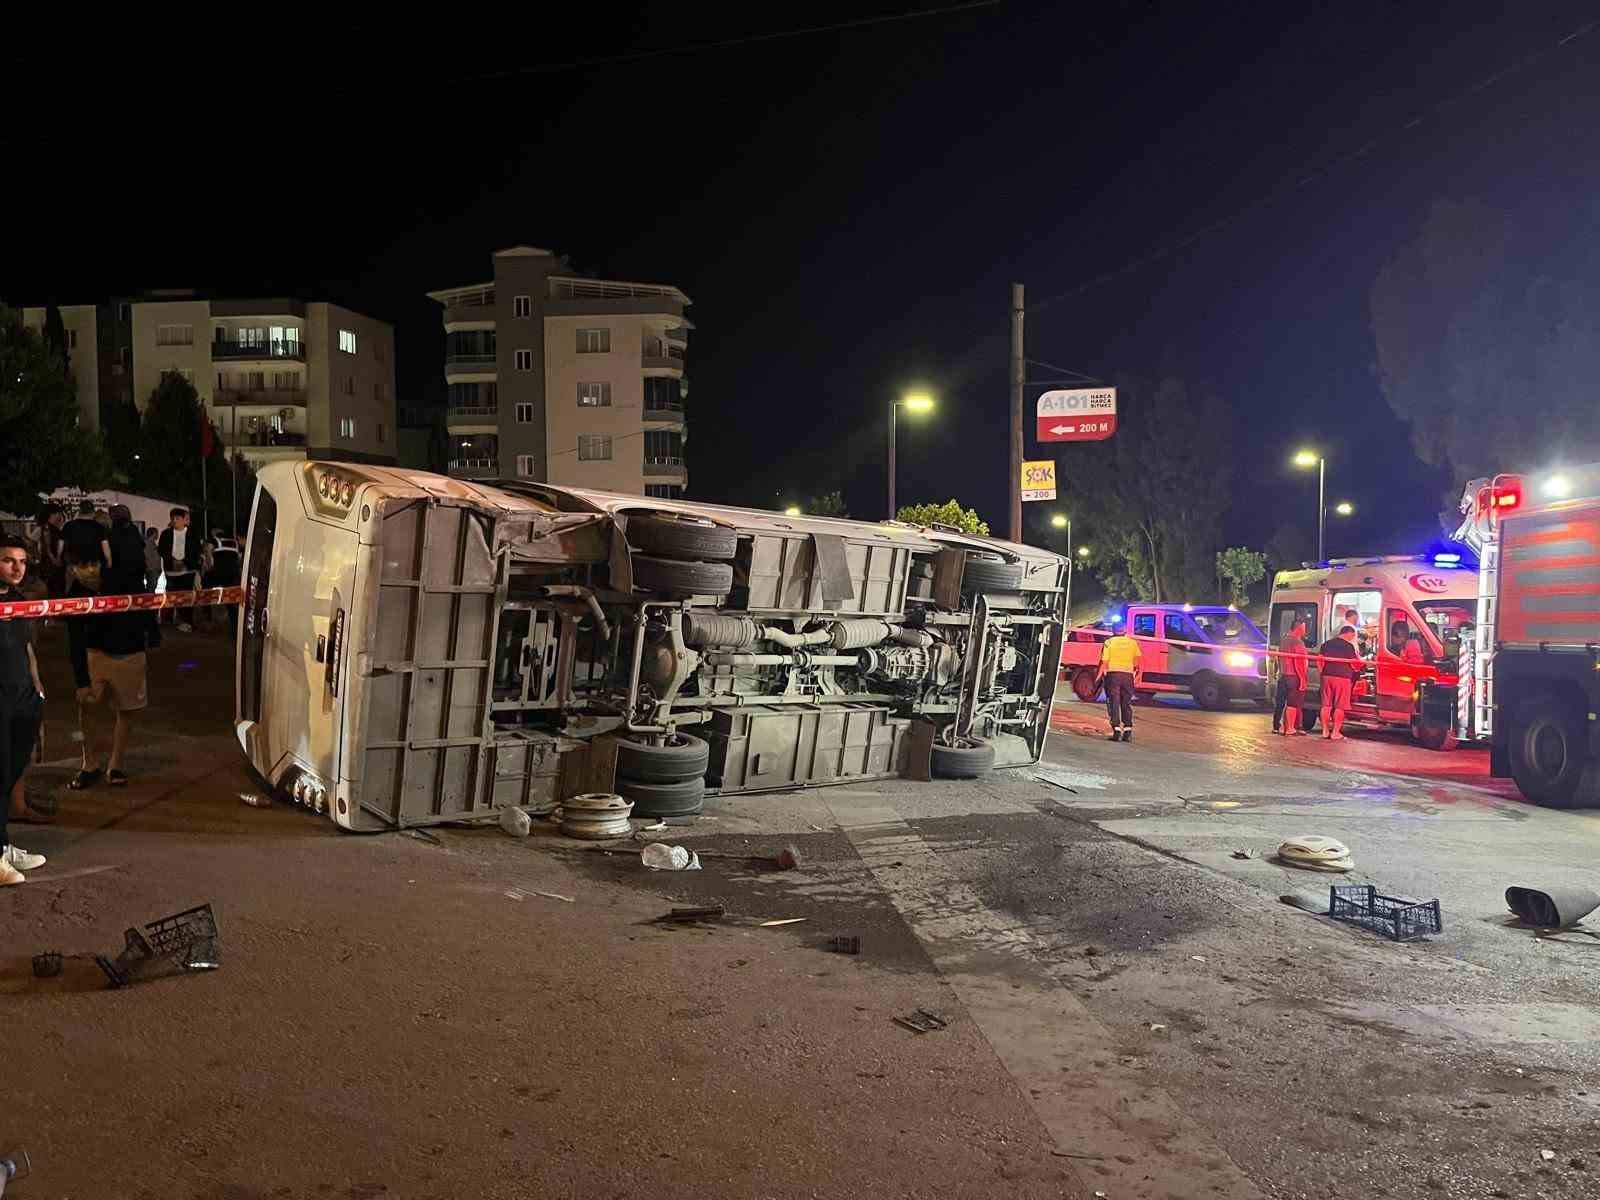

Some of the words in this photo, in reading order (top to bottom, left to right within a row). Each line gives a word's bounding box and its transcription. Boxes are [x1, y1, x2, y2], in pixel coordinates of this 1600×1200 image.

[1079, 423, 1097, 433] 200
[1099, 422, 1108, 432] M
[1420, 579, 1446, 587] 112
